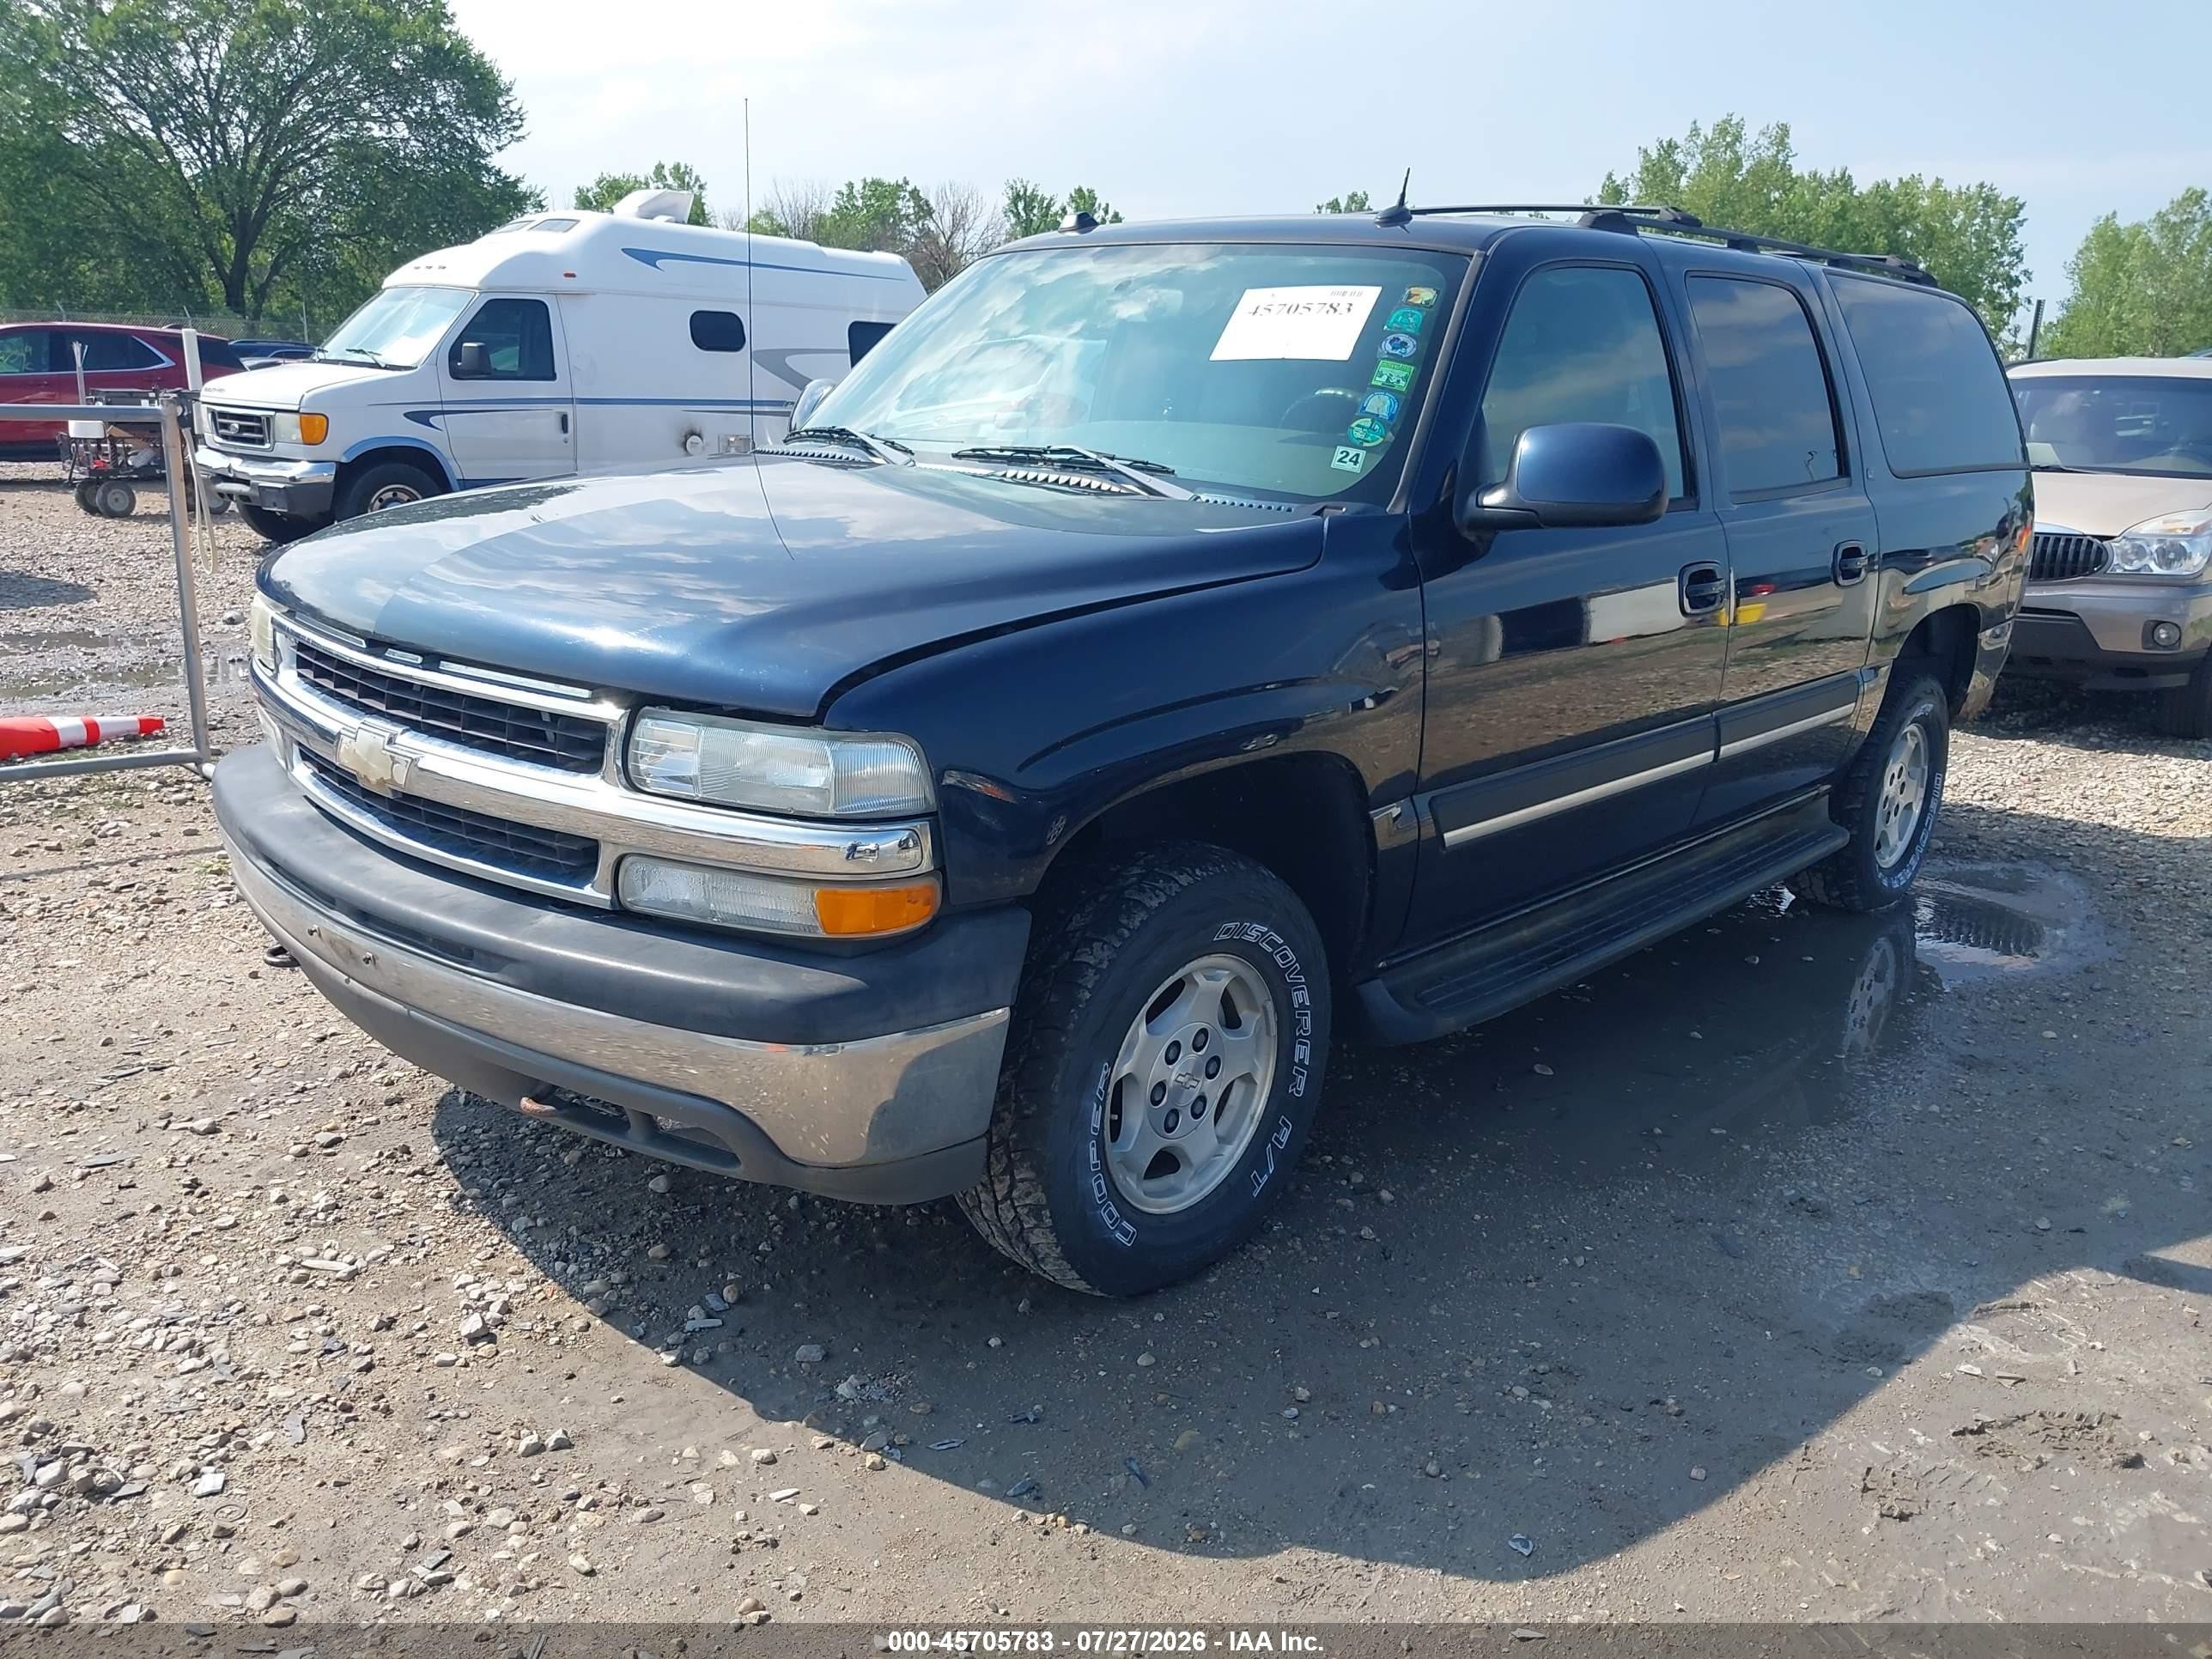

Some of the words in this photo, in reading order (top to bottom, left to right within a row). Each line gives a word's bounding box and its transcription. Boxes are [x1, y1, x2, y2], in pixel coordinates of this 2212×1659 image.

[1247, 302, 1354, 317] 45705783
[1337, 450, 1361, 466] 24
[1213, 921, 1312, 1098] DISCOVERER
[1089, 1061, 1138, 1247] COOPER
[1250, 1115, 1293, 1199] A/T
